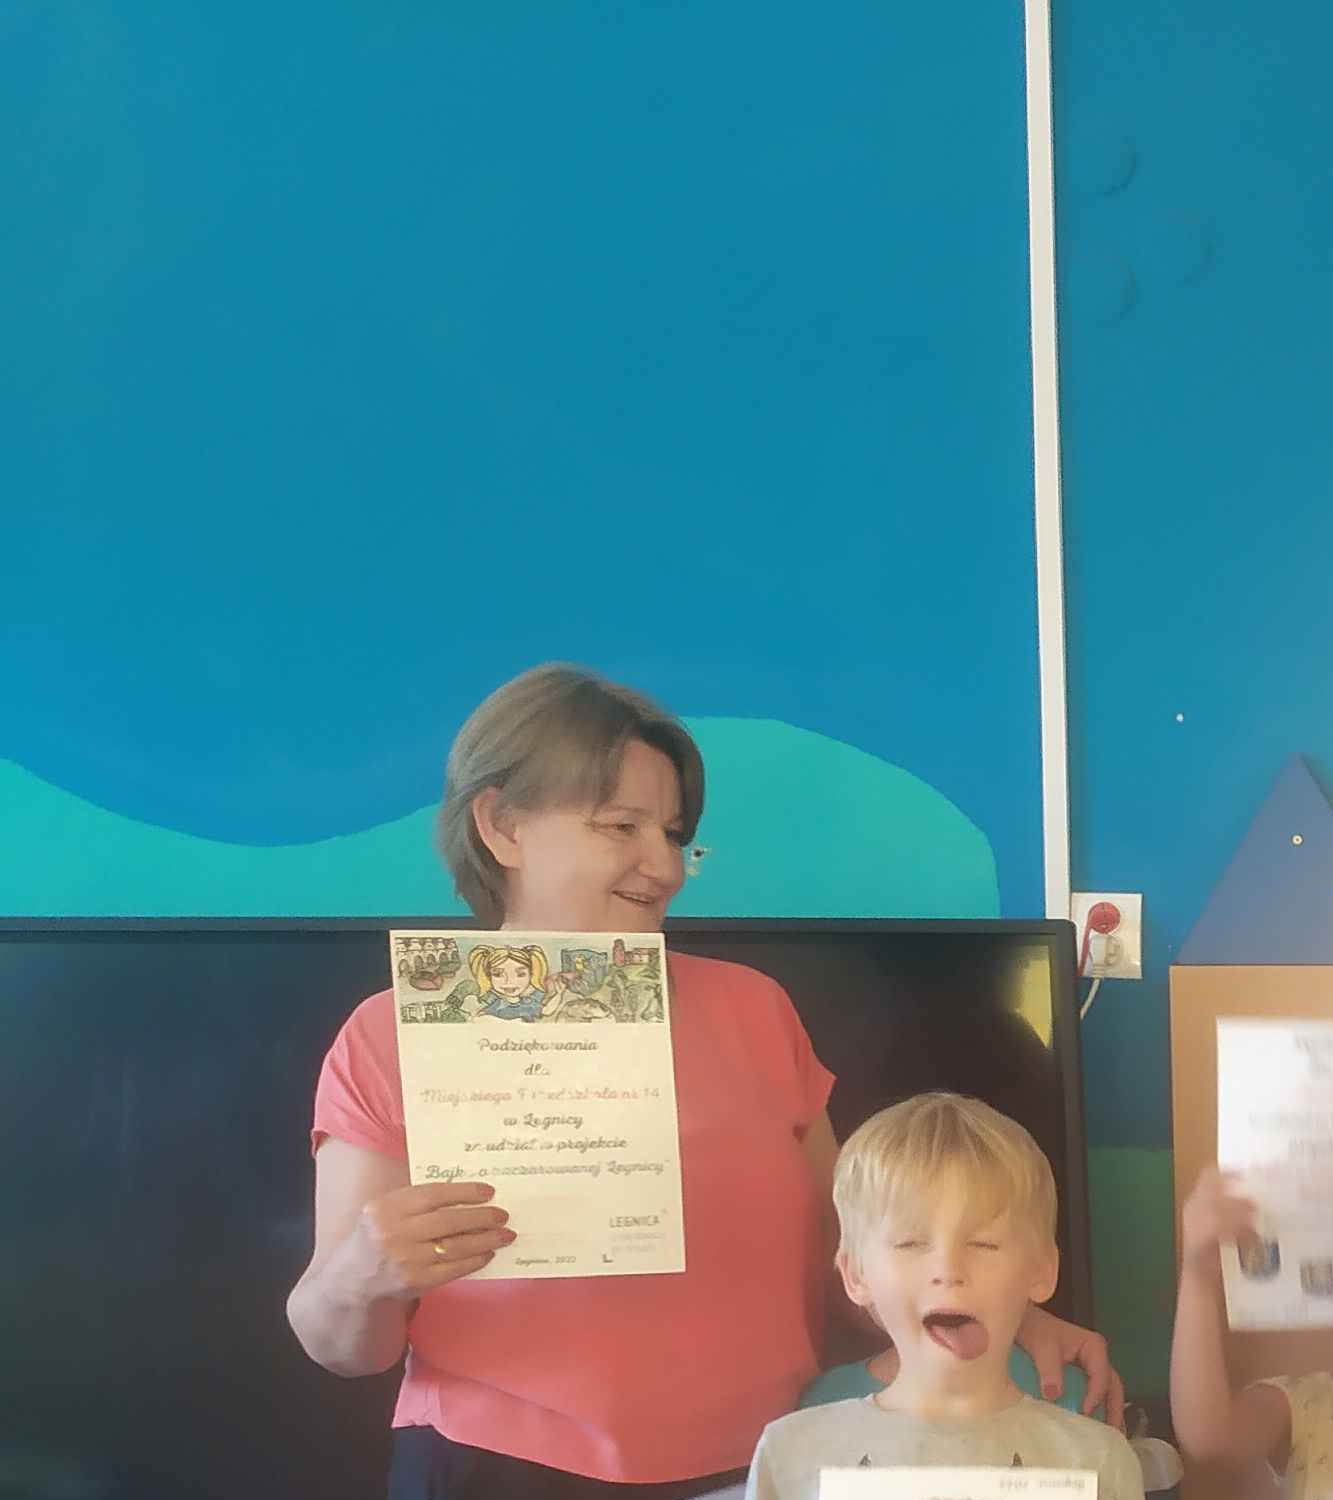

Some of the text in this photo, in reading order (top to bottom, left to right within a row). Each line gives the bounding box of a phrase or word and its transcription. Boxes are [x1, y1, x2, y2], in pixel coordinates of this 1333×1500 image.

[503, 1112, 584, 1131] w Legnicy
[556, 1136, 629, 1155] projekcie
